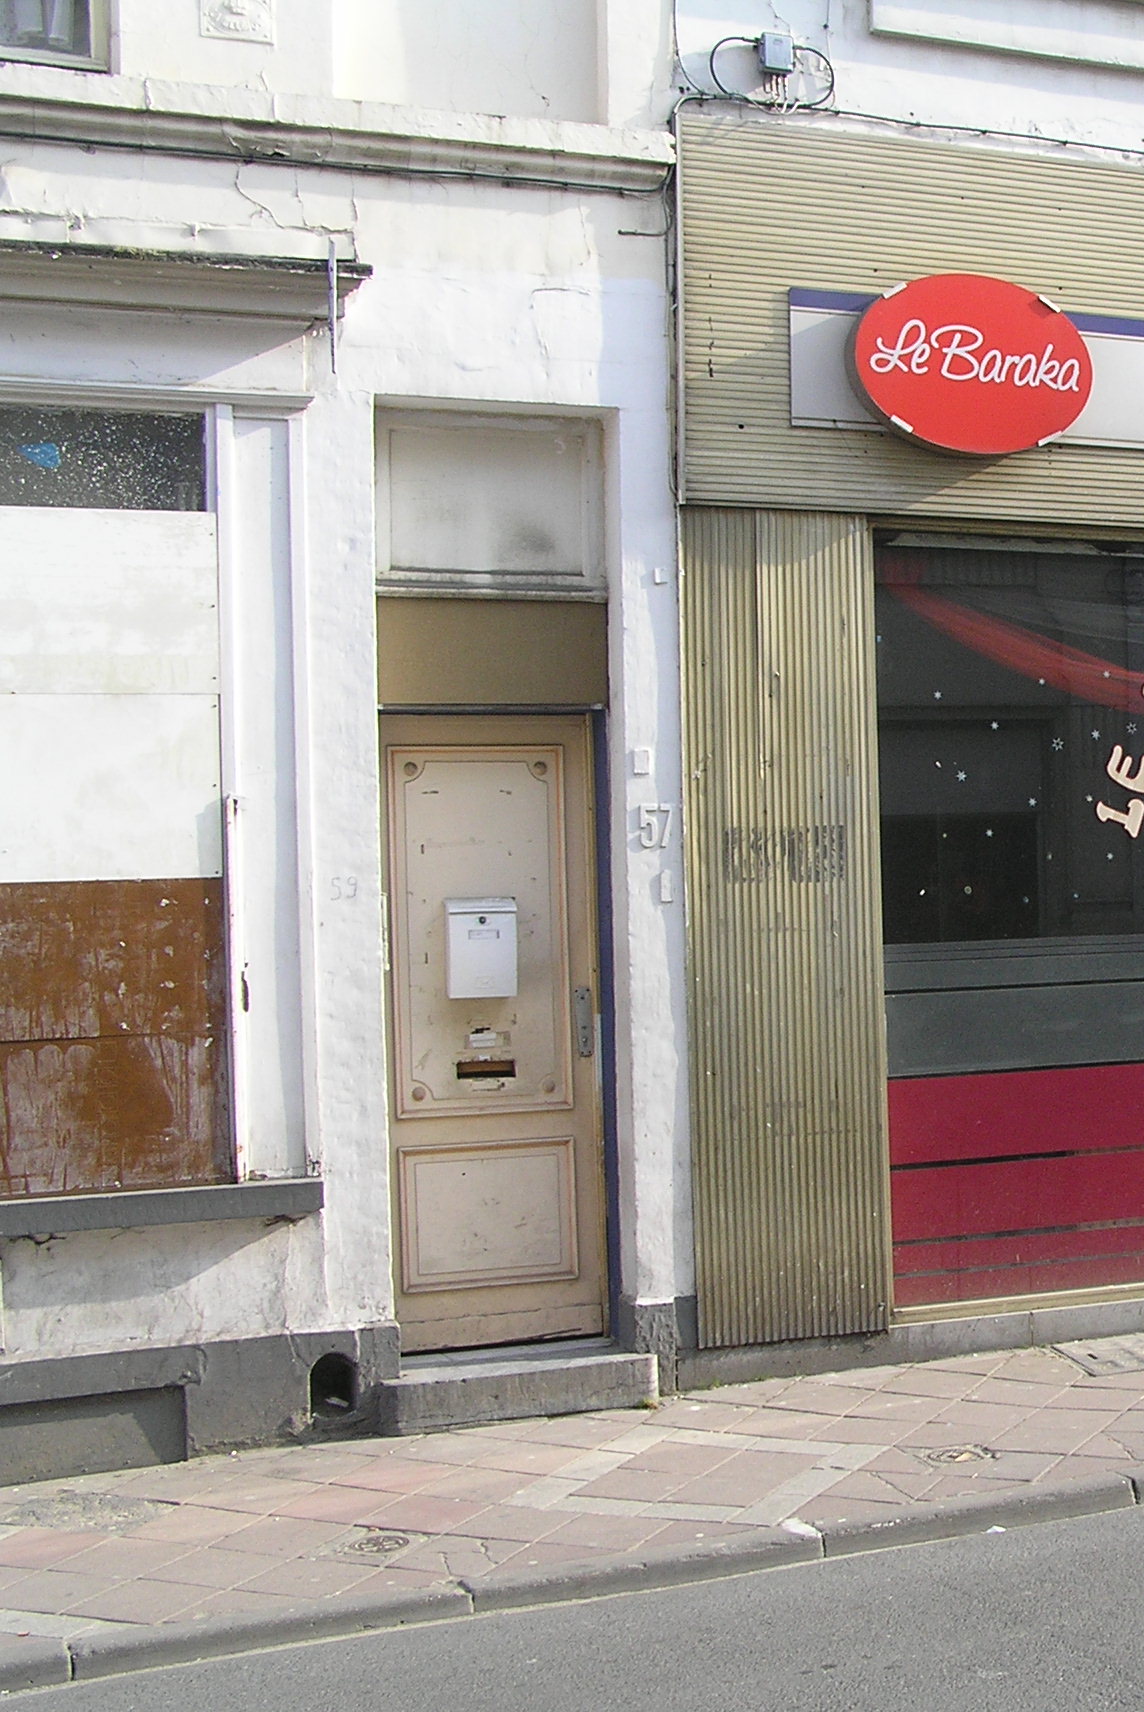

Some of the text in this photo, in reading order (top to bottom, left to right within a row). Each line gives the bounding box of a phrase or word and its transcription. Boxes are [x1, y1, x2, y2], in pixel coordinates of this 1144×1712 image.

[869, 318, 1080, 392] Le Baraka
[639, 803, 673, 849] 57
[330, 876, 358, 902] 59
